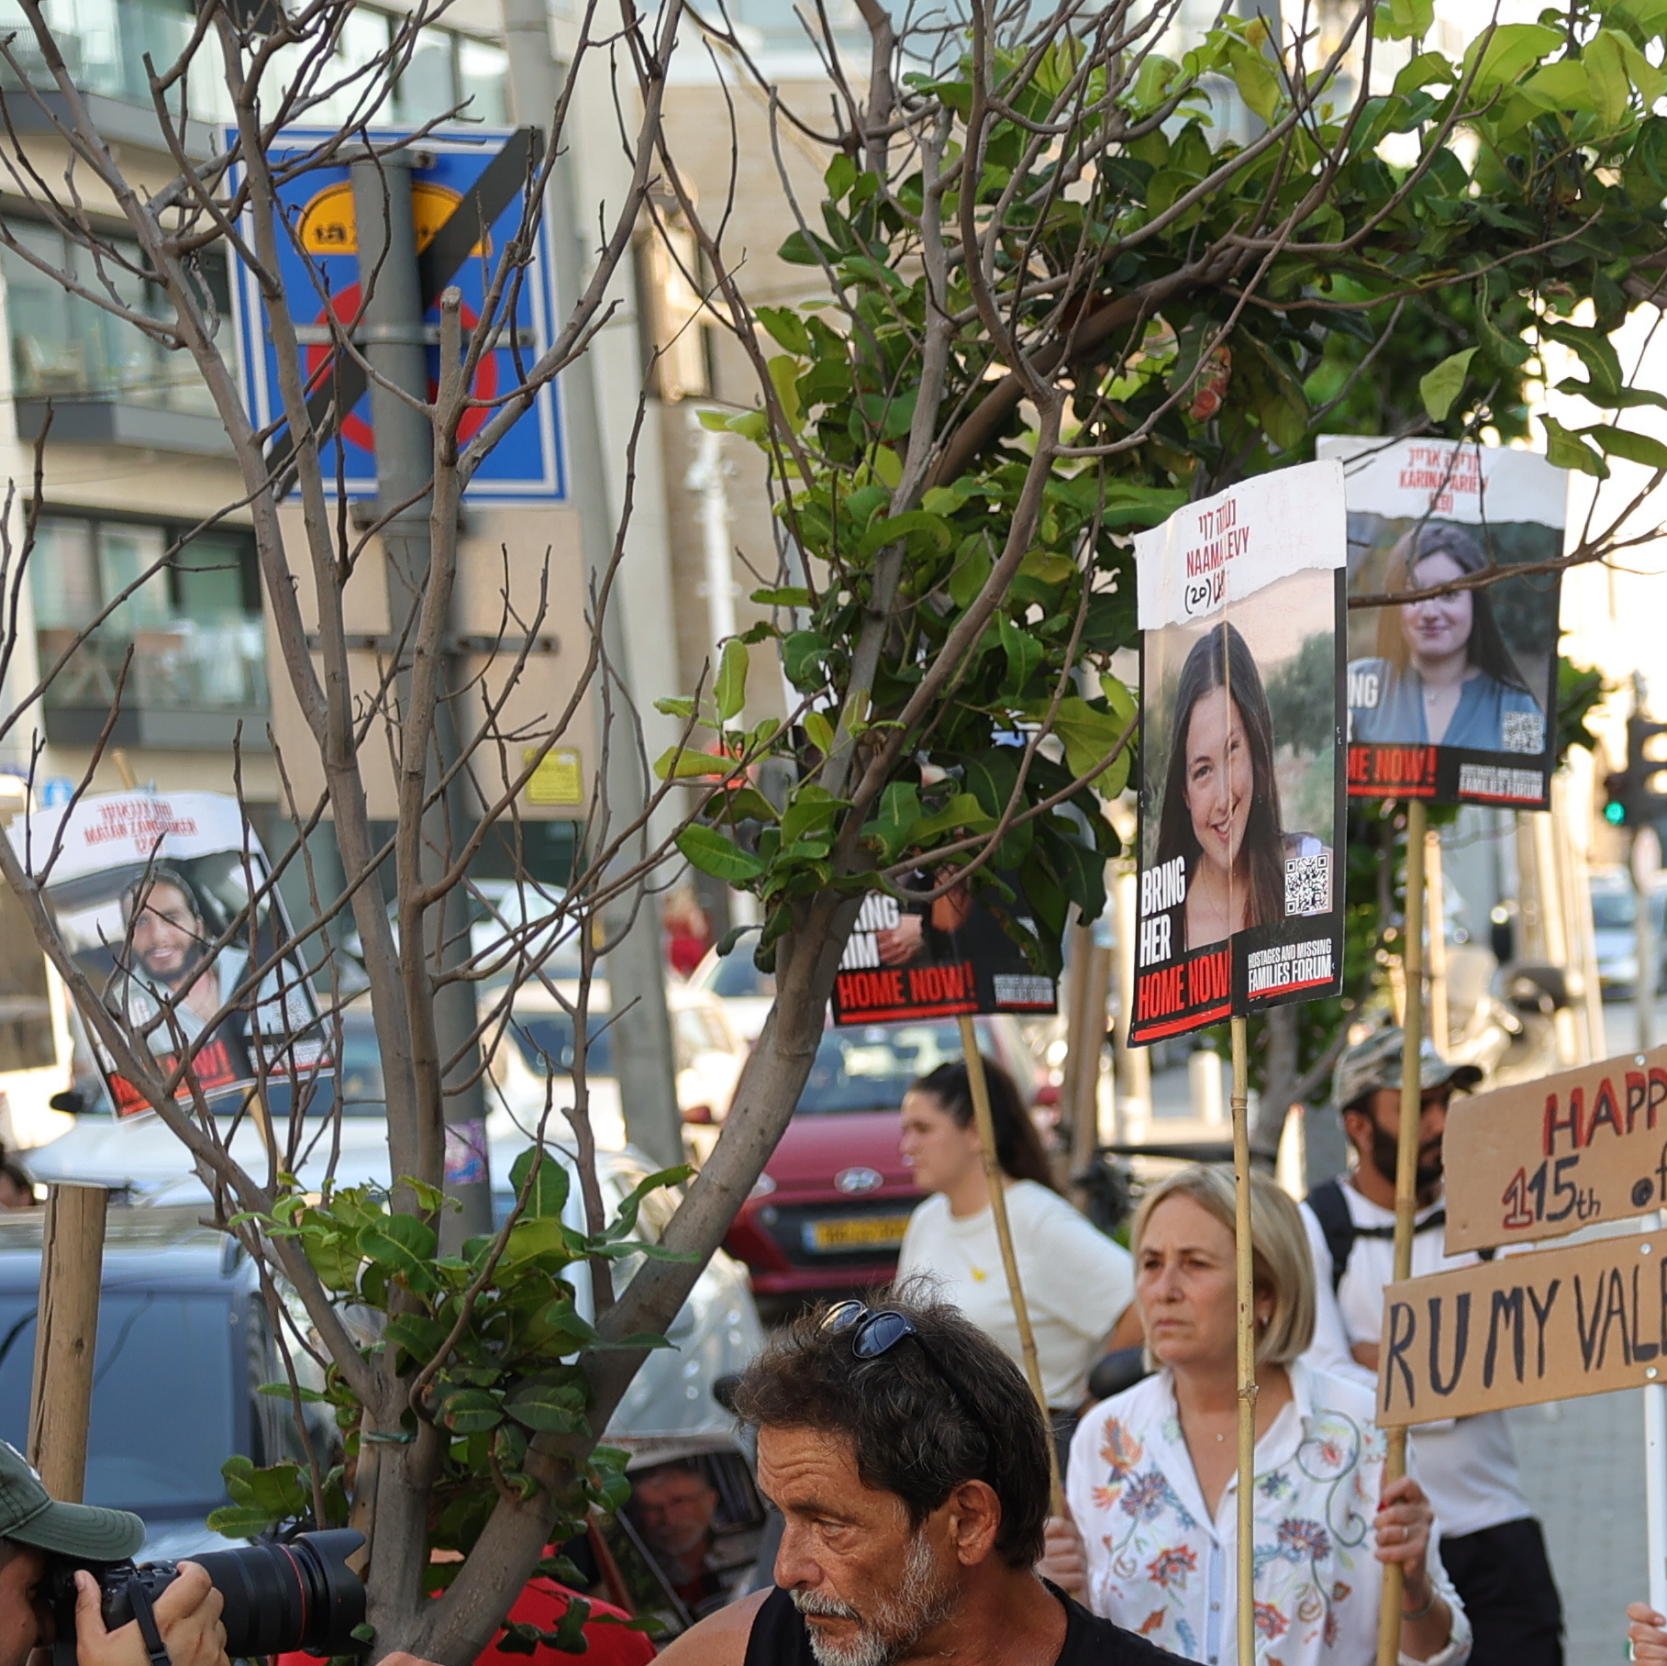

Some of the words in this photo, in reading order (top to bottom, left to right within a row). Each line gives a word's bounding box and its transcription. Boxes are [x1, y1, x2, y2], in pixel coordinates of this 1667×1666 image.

[1186, 540, 1223, 578] NAAMA
[1224, 527, 1249, 560] LEVY
[1375, 745, 1438, 783] NOW!
[1141, 855, 1186, 917] BRING
[1139, 914, 1172, 968] HER
[1248, 947, 1281, 970] HOSTAGES
[1281, 944, 1295, 961] AND
[1296, 938, 1332, 959] MISSING
[837, 969, 905, 1009] HOME
[909, 960, 976, 1002] NOW!
[1138, 964, 1184, 1022] HOME
[1248, 962, 1290, 993] FAMILIES
[1292, 955, 1332, 984] FORUM
